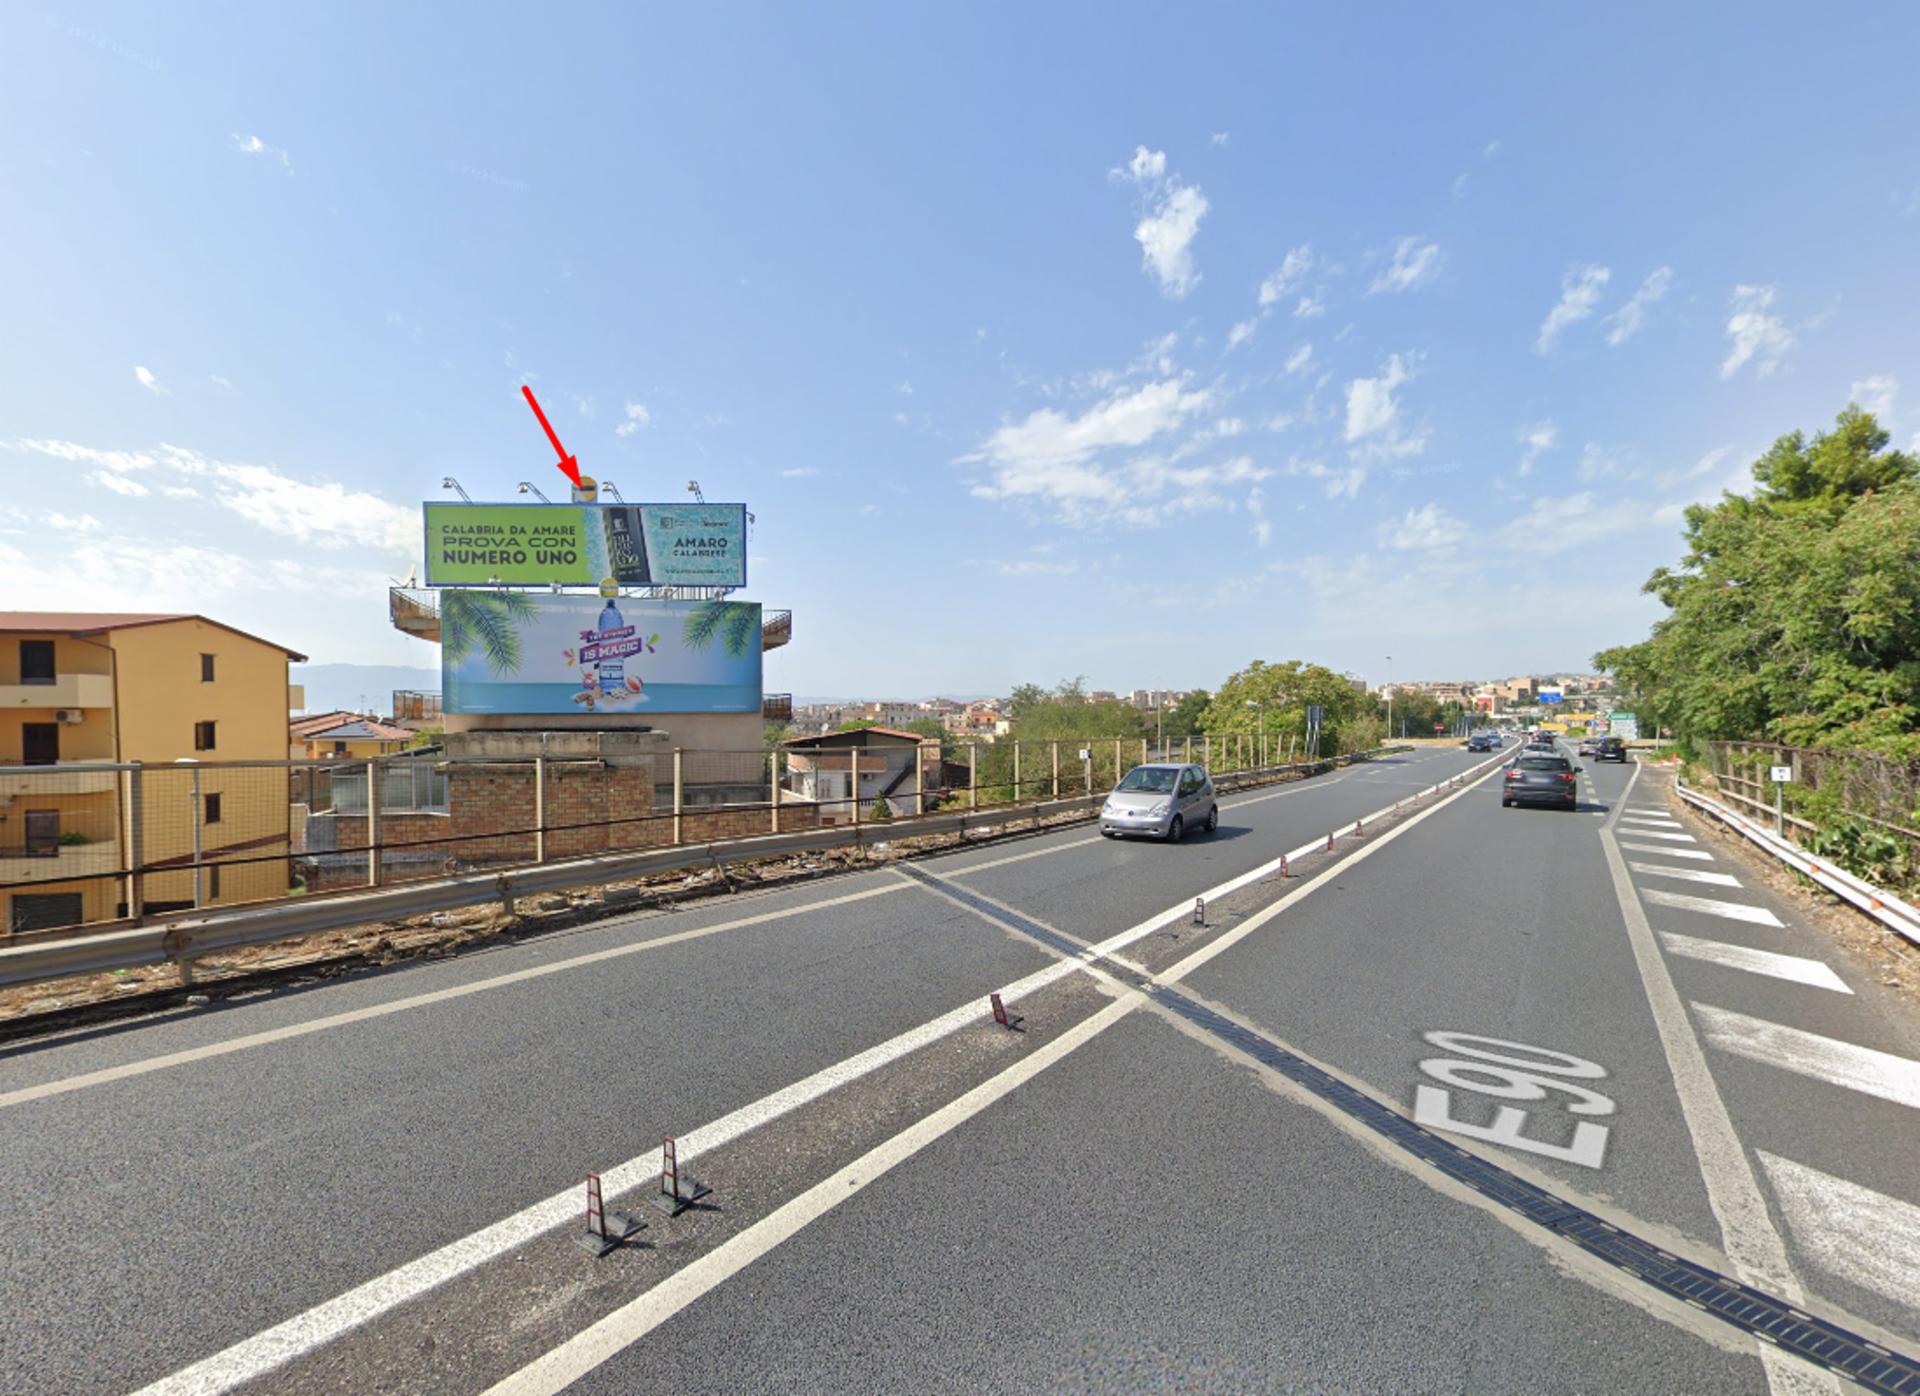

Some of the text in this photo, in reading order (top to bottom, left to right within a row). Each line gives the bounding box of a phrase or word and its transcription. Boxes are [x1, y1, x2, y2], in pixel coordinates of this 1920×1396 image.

[442, 525, 576, 536] CALABRIA DA AMARE
[443, 537, 576, 548] PROVA CON
[674, 537, 728, 548] AMARO
[443, 550, 577, 564] NUMERO UNO
[583, 641, 639, 660] IS MAGIC
[1414, 1031, 1616, 1169] E90
